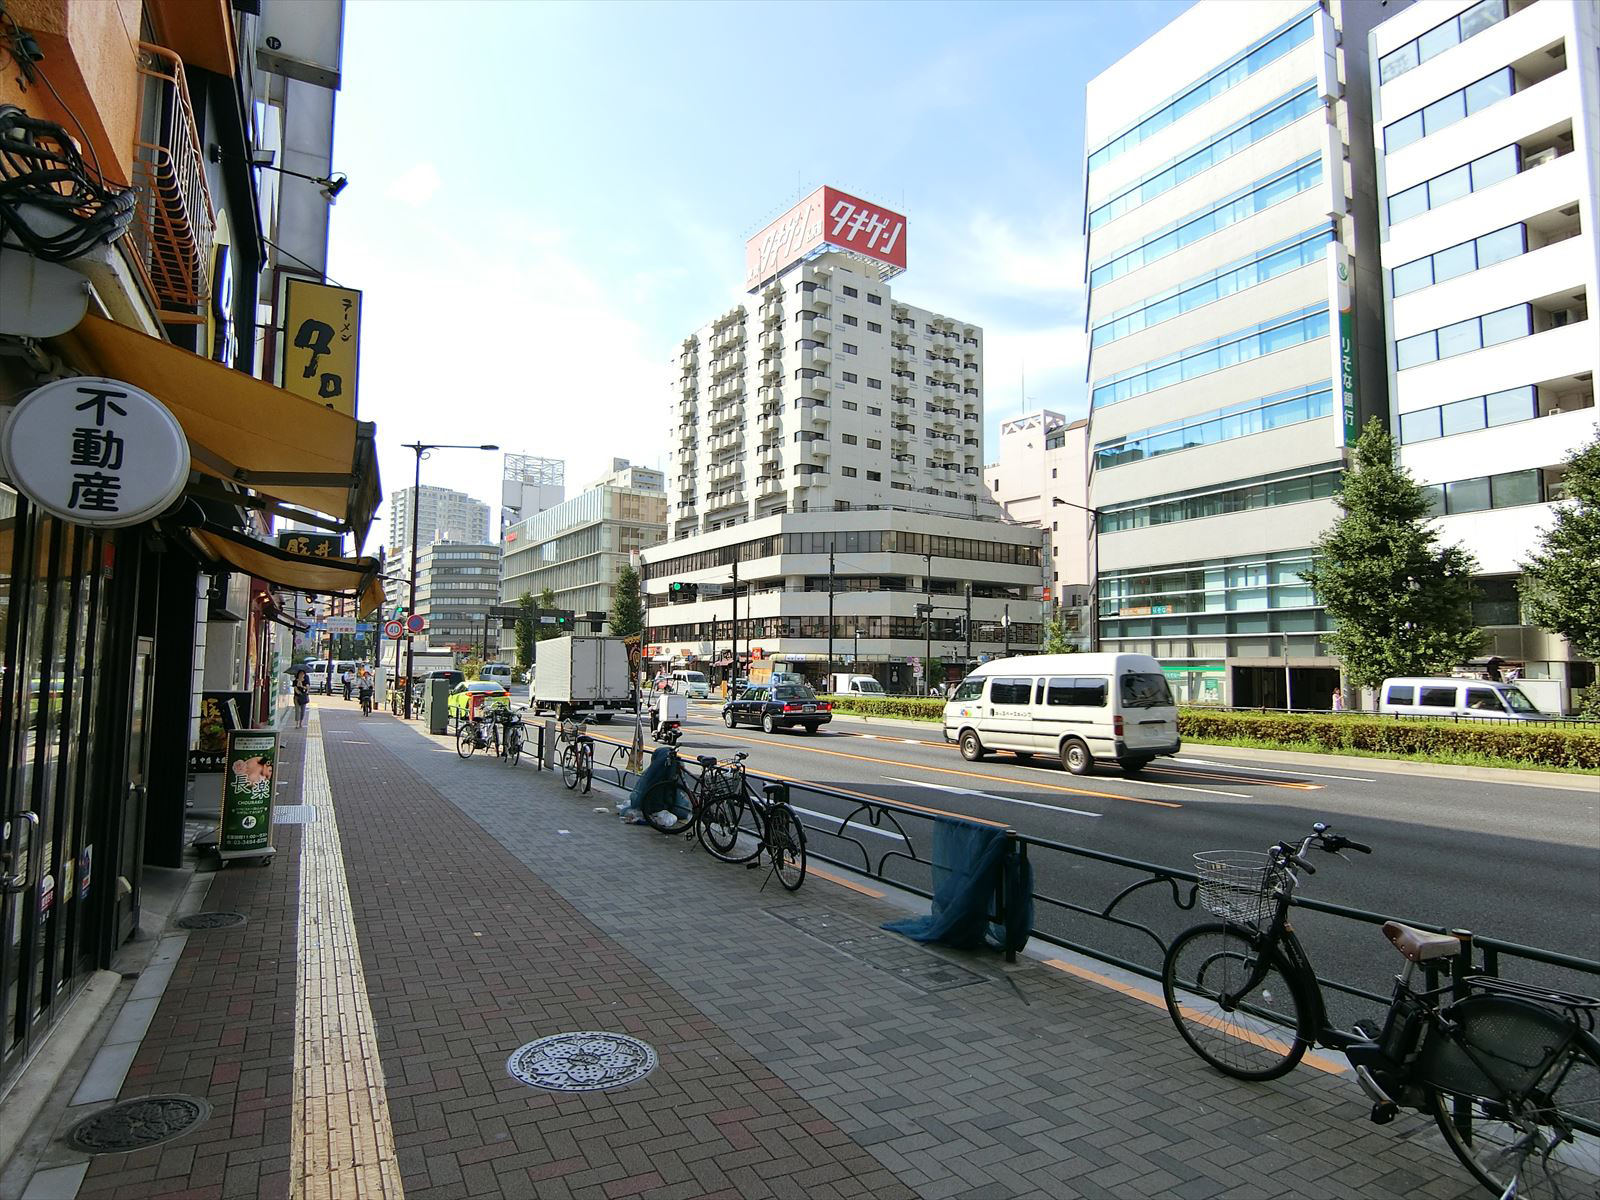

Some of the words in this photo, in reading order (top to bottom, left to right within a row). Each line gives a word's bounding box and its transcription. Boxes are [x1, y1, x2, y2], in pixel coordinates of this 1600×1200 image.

[830, 200, 902, 254] タキゲン
[341, 298, 353, 342] ラーメン
[1341, 336, 1354, 427] りそな銀行
[68, 387, 128, 512] 不動産
[388, 625, 399, 634] 40
[231, 774, 271, 800] 長楽
